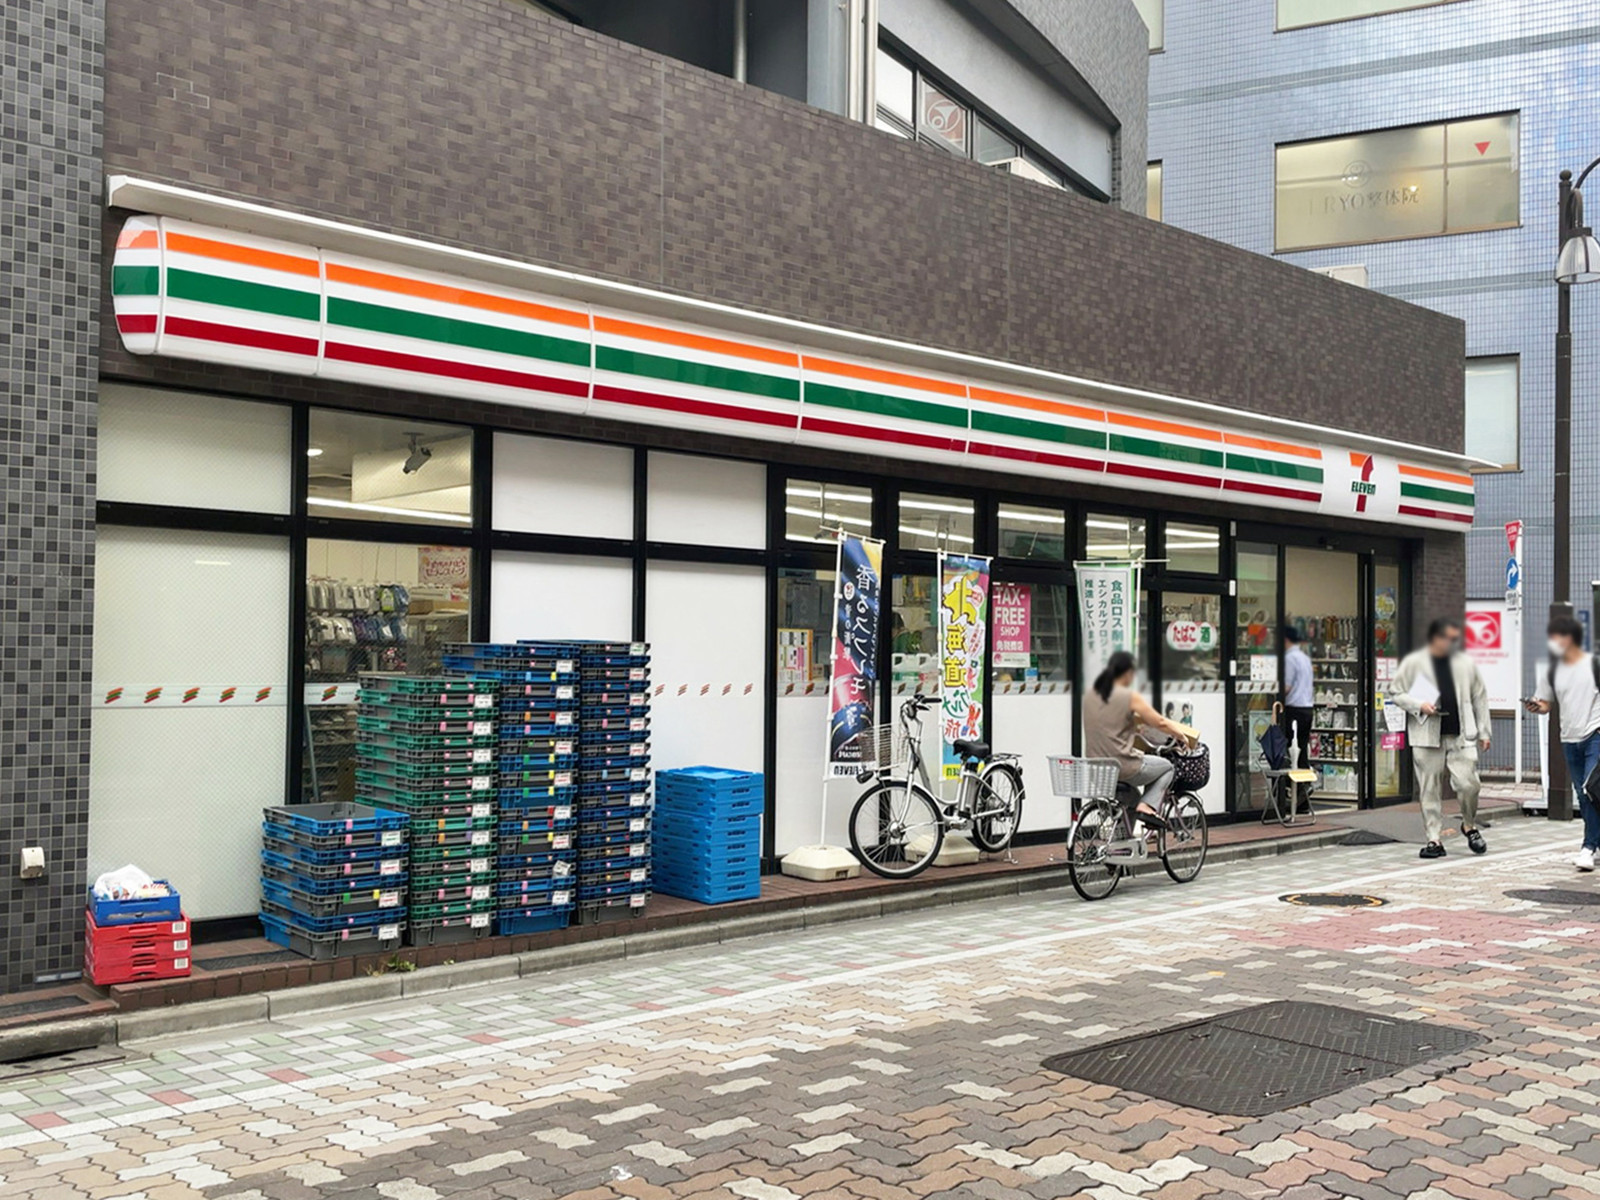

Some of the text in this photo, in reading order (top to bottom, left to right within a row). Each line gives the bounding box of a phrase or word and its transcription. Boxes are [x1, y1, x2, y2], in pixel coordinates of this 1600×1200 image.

[994, 607, 1026, 625] FREE
[1000, 626, 1020, 637] SHOP
[1173, 625, 1211, 643] たばこ 酒
